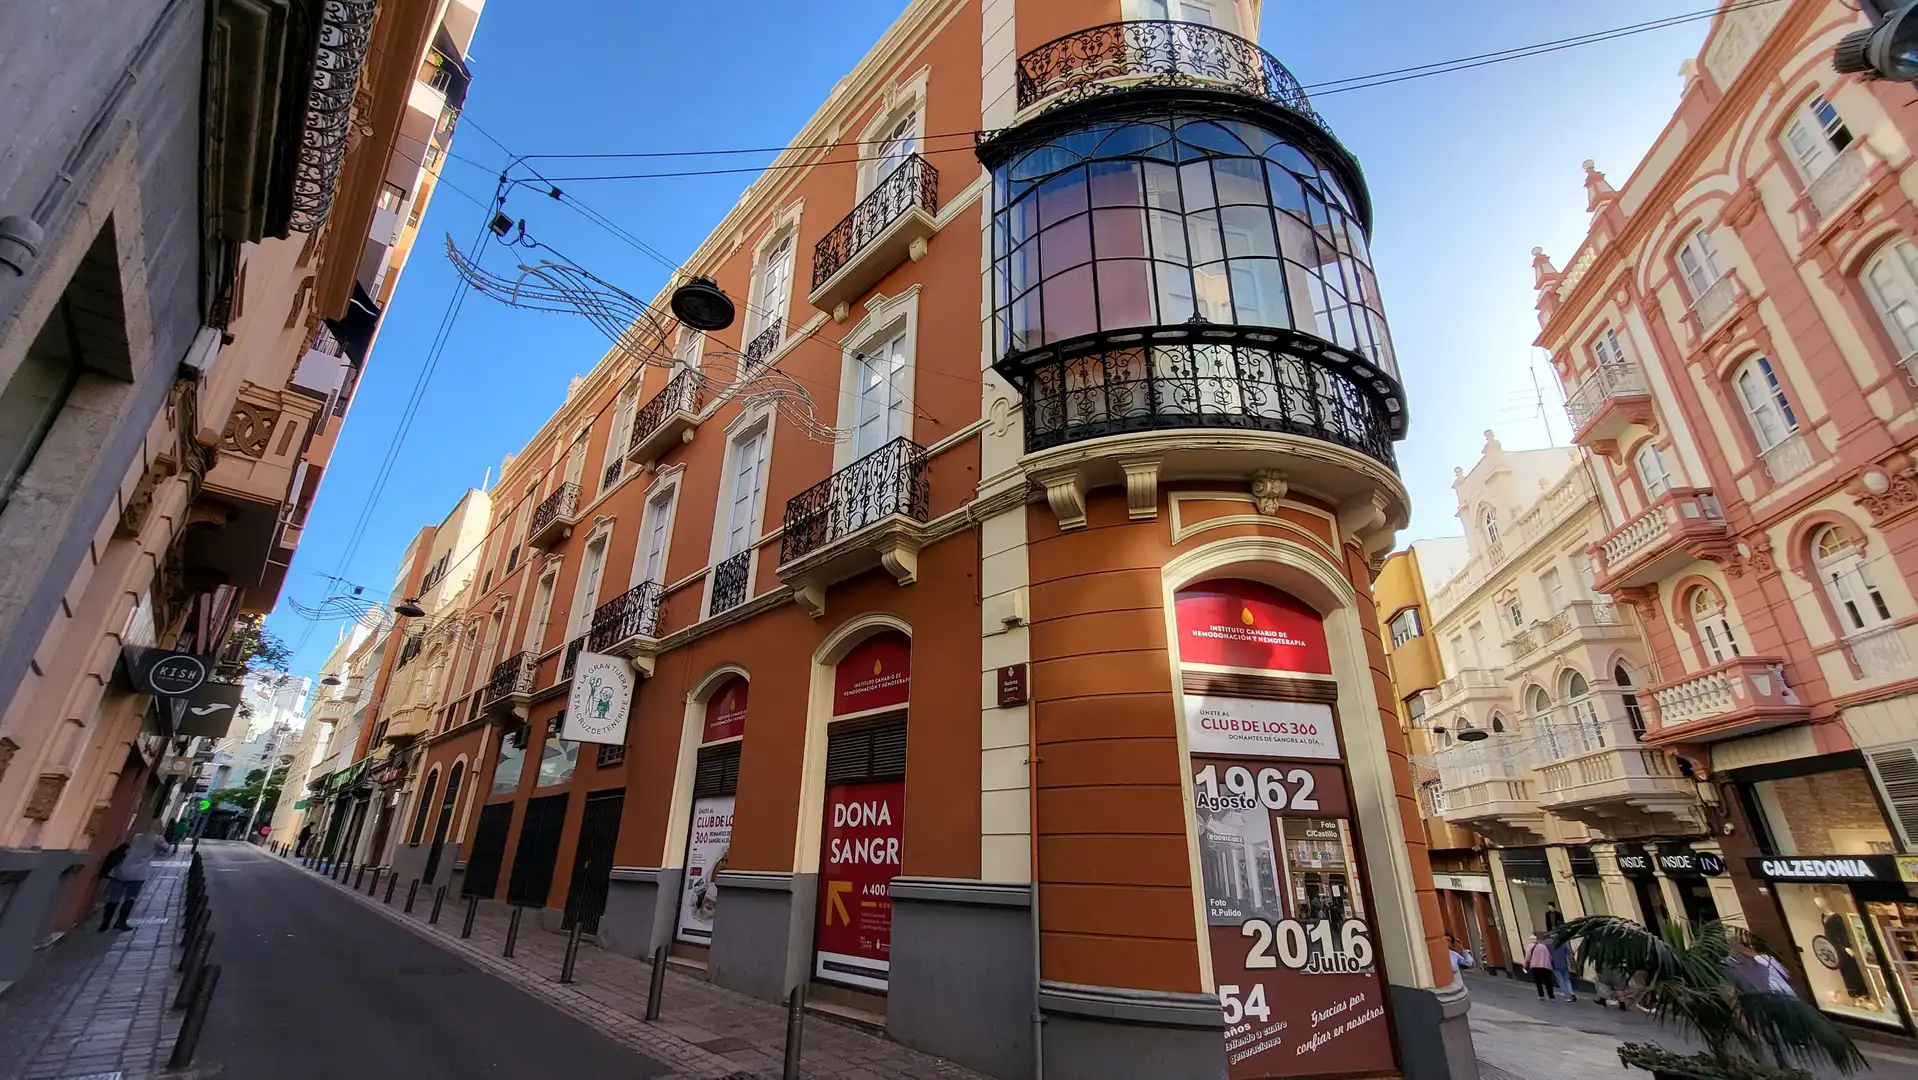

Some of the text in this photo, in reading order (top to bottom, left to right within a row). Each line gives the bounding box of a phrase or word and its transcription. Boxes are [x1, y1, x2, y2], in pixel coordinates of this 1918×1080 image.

[1192, 629, 1251, 641] HEMODONACIÓN
[1258, 637, 1306, 646] HEMOTERAPIA
[1210, 625, 1244, 634] INSTITUTO
[1246, 629, 1277, 637] CANARIO
[160, 666, 197, 680] KISH
[579, 663, 628, 690] LA GRAN TIJERA
[576, 714, 592, 732] CRUZ
[602, 700, 628, 734] TENERIFE
[1201, 718, 1317, 735] CLUB DE LOS 300
[1229, 734, 1263, 742] DONANTES
[1195, 764, 1319, 811] 1962
[1197, 793, 1257, 811] Agosto
[697, 816, 715, 828] CLUB
[715, 815, 725, 827] DE
[833, 800, 892, 828] DONA
[1306, 829, 1337, 838] C/Castillo
[1321, 821, 1335, 829] Foto
[695, 832, 709, 844] 300
[1619, 857, 1646, 868] INSIDE
[1660, 855, 1692, 868] INSIDE
[1700, 857, 1719, 871] IN
[1762, 860, 1875, 877] CALZEDONIA
[863, 884, 886, 896] A 400
[1211, 908, 1241, 917] R.Pulido
[1241, 918, 1373, 969] 2016
[1309, 952, 1360, 973] Julio
[1219, 983, 1271, 1024] 54
[1310, 992, 1365, 1028] Gracias por
[1224, 1022, 1251, 1039] años
[1263, 1020, 1288, 1037] cuatro
[1296, 1005, 1385, 1056] confiar en nosotros
[1230, 1036, 1281, 1065] generaciones
